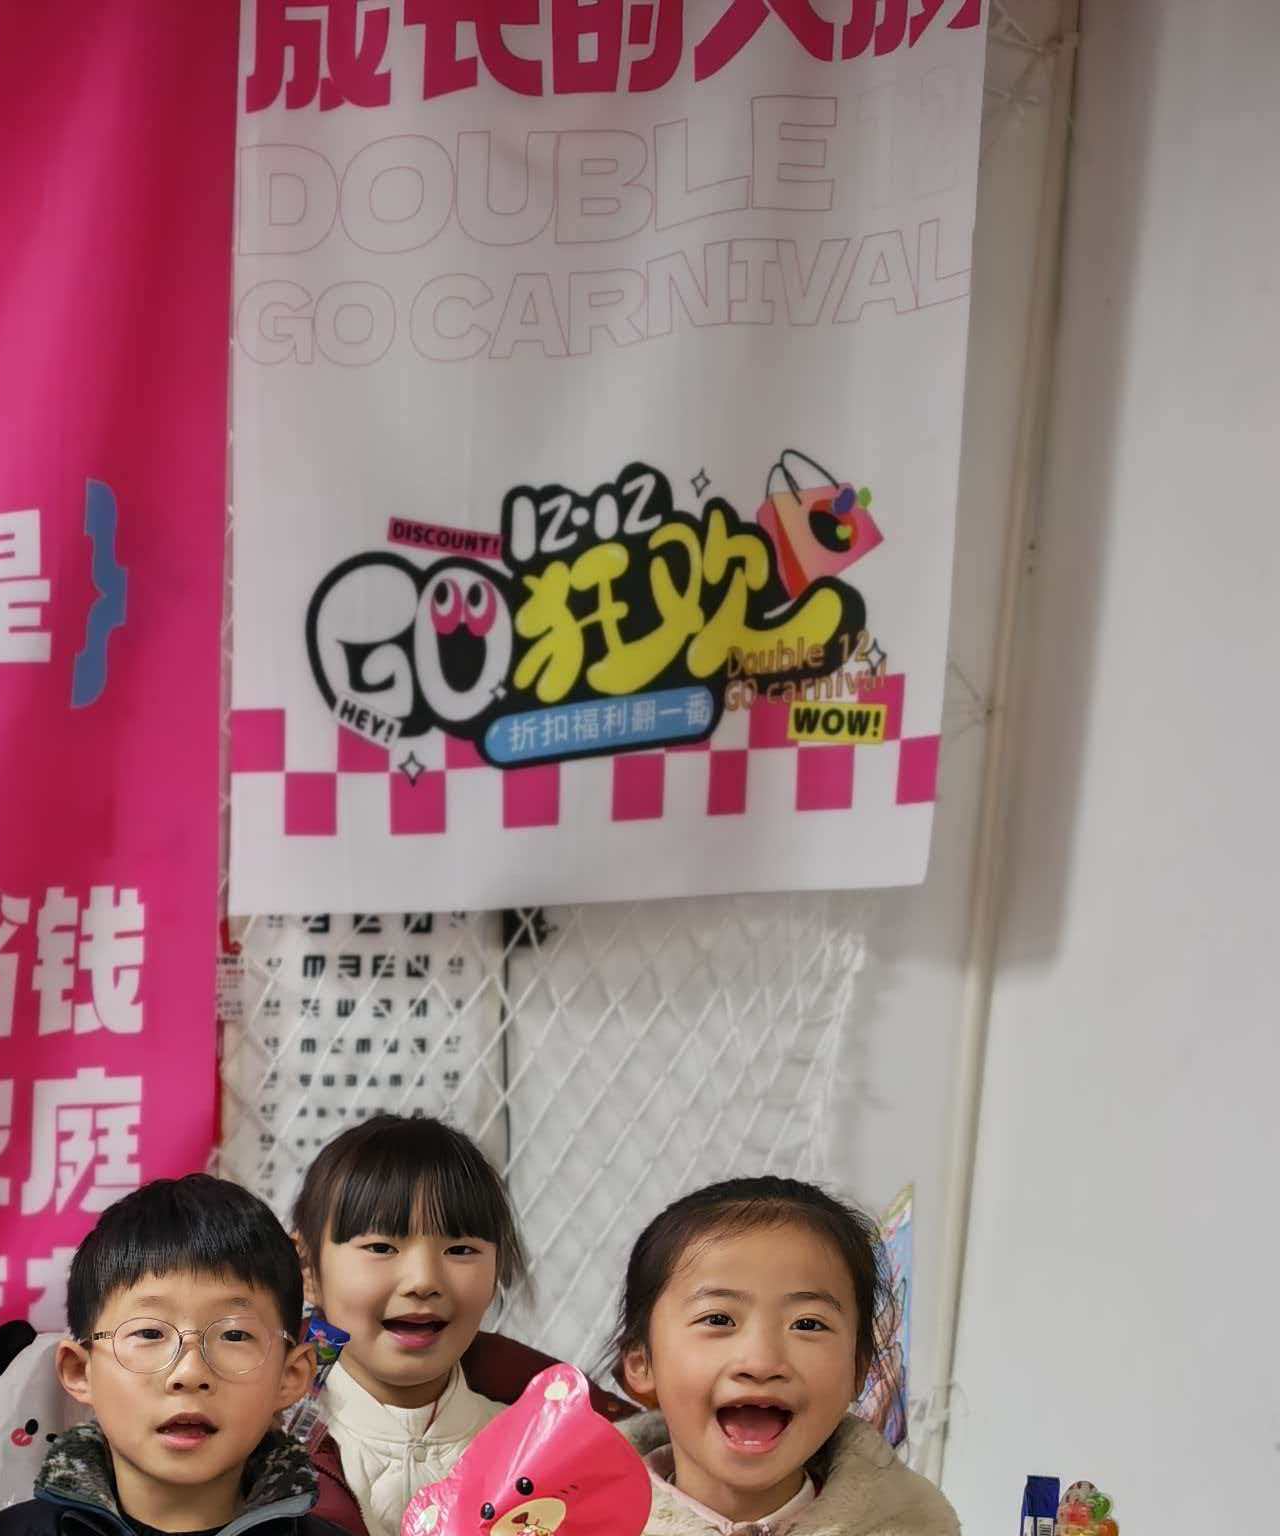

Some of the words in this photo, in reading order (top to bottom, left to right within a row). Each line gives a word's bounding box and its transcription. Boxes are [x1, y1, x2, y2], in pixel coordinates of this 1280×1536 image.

[238, 95, 837, 256] DOUBLE
[238, 279, 396, 367] GO
[409, 219, 972, 364] CARNIVAL
[391, 520, 500, 556] DISCOUNT!
[339, 698, 397, 743] HEY!
[793, 706, 882, 737] WOW!
